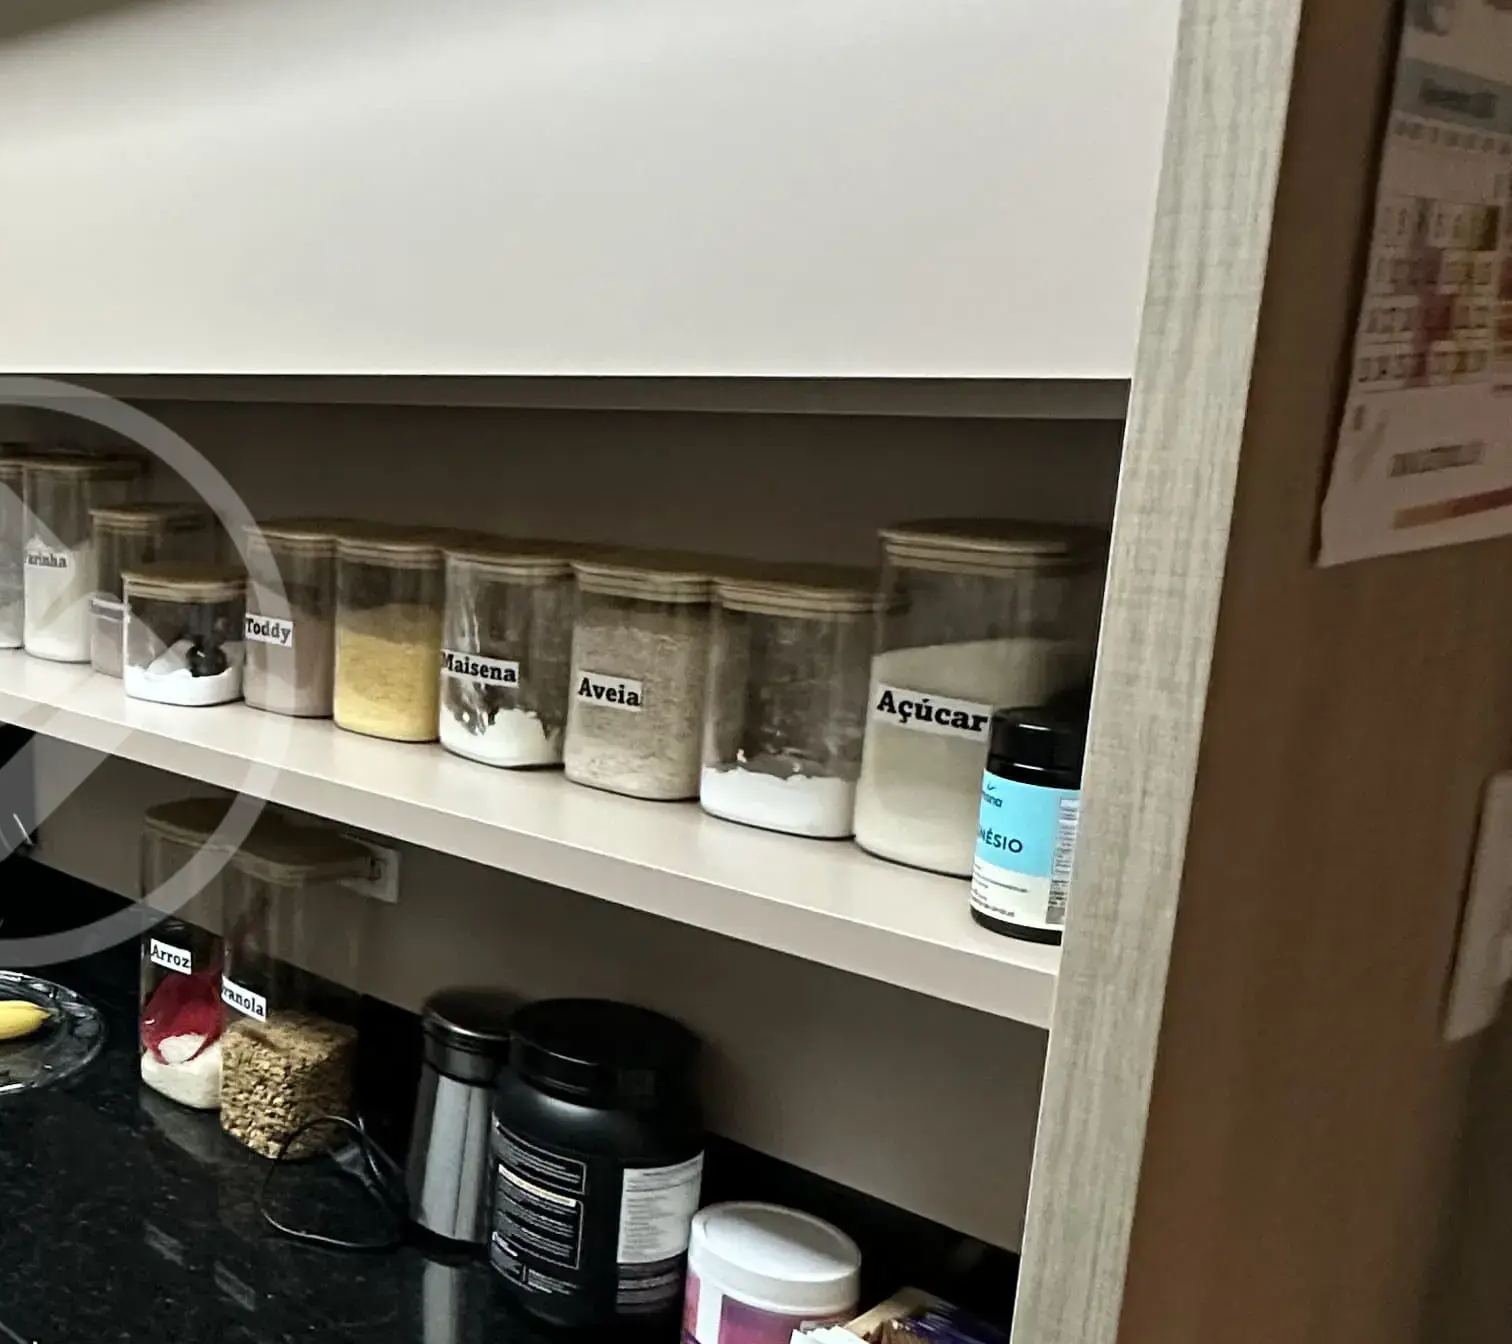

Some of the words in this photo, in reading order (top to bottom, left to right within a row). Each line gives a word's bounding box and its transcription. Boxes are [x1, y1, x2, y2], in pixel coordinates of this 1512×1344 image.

[24, 552, 68, 569] arinha
[246, 618, 292, 644] Toddy
[441, 652, 517, 683] Maisena
[578, 677, 641, 707] Aveia
[876, 689, 988, 732] Açúcar
[150, 943, 191, 969] Arroz
[221, 985, 265, 1017] ranola
